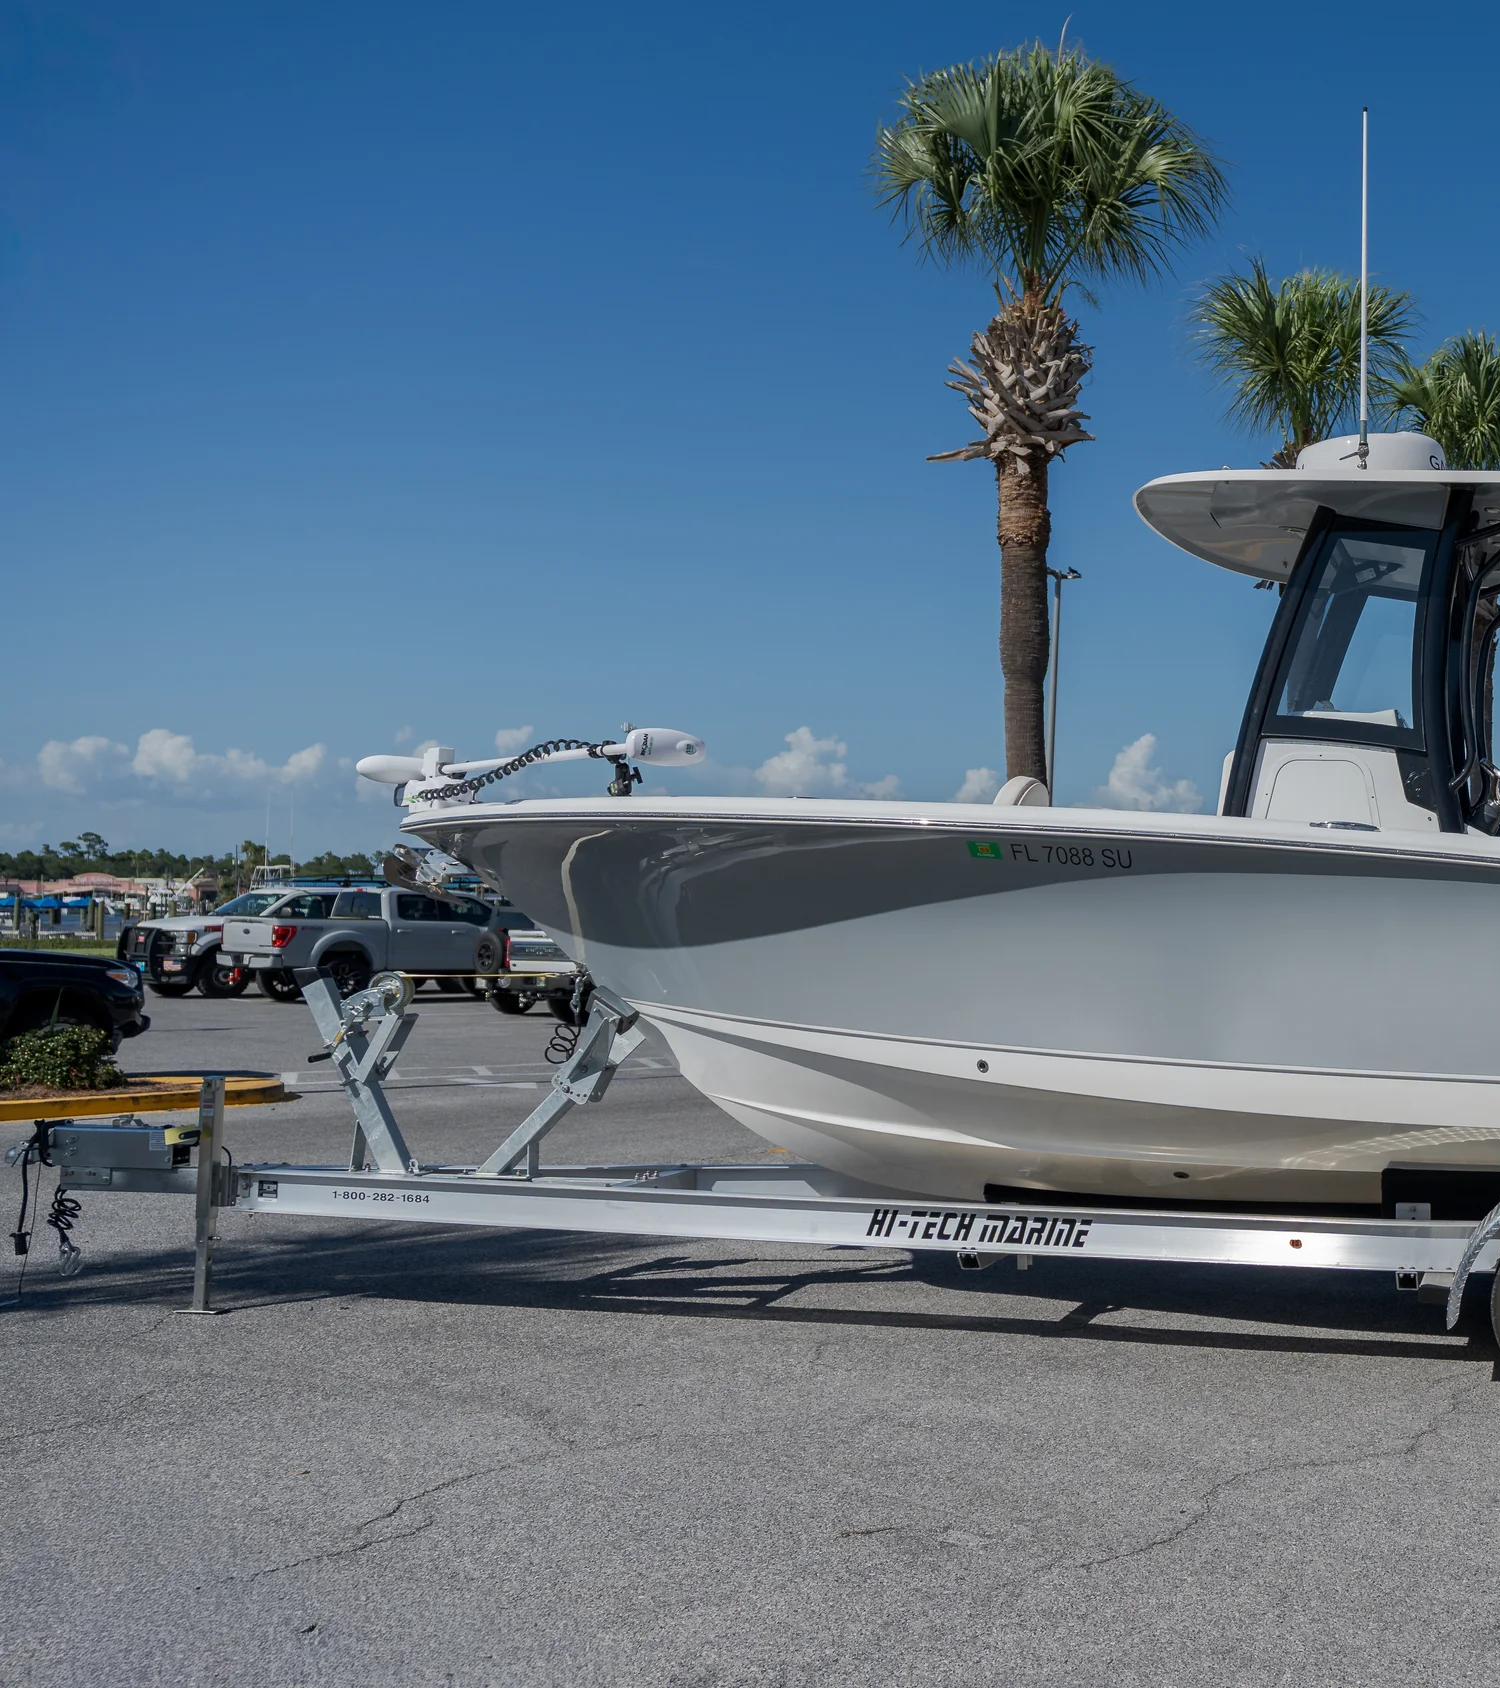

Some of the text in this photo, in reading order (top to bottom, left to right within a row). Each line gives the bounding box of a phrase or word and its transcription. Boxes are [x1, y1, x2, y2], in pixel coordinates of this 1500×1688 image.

[1010, 843, 1132, 869] FL 7088 SU
[332, 1190, 430, 1204] 1-800-282-1684
[866, 1208, 1094, 1248] HI-TECH MARINE
